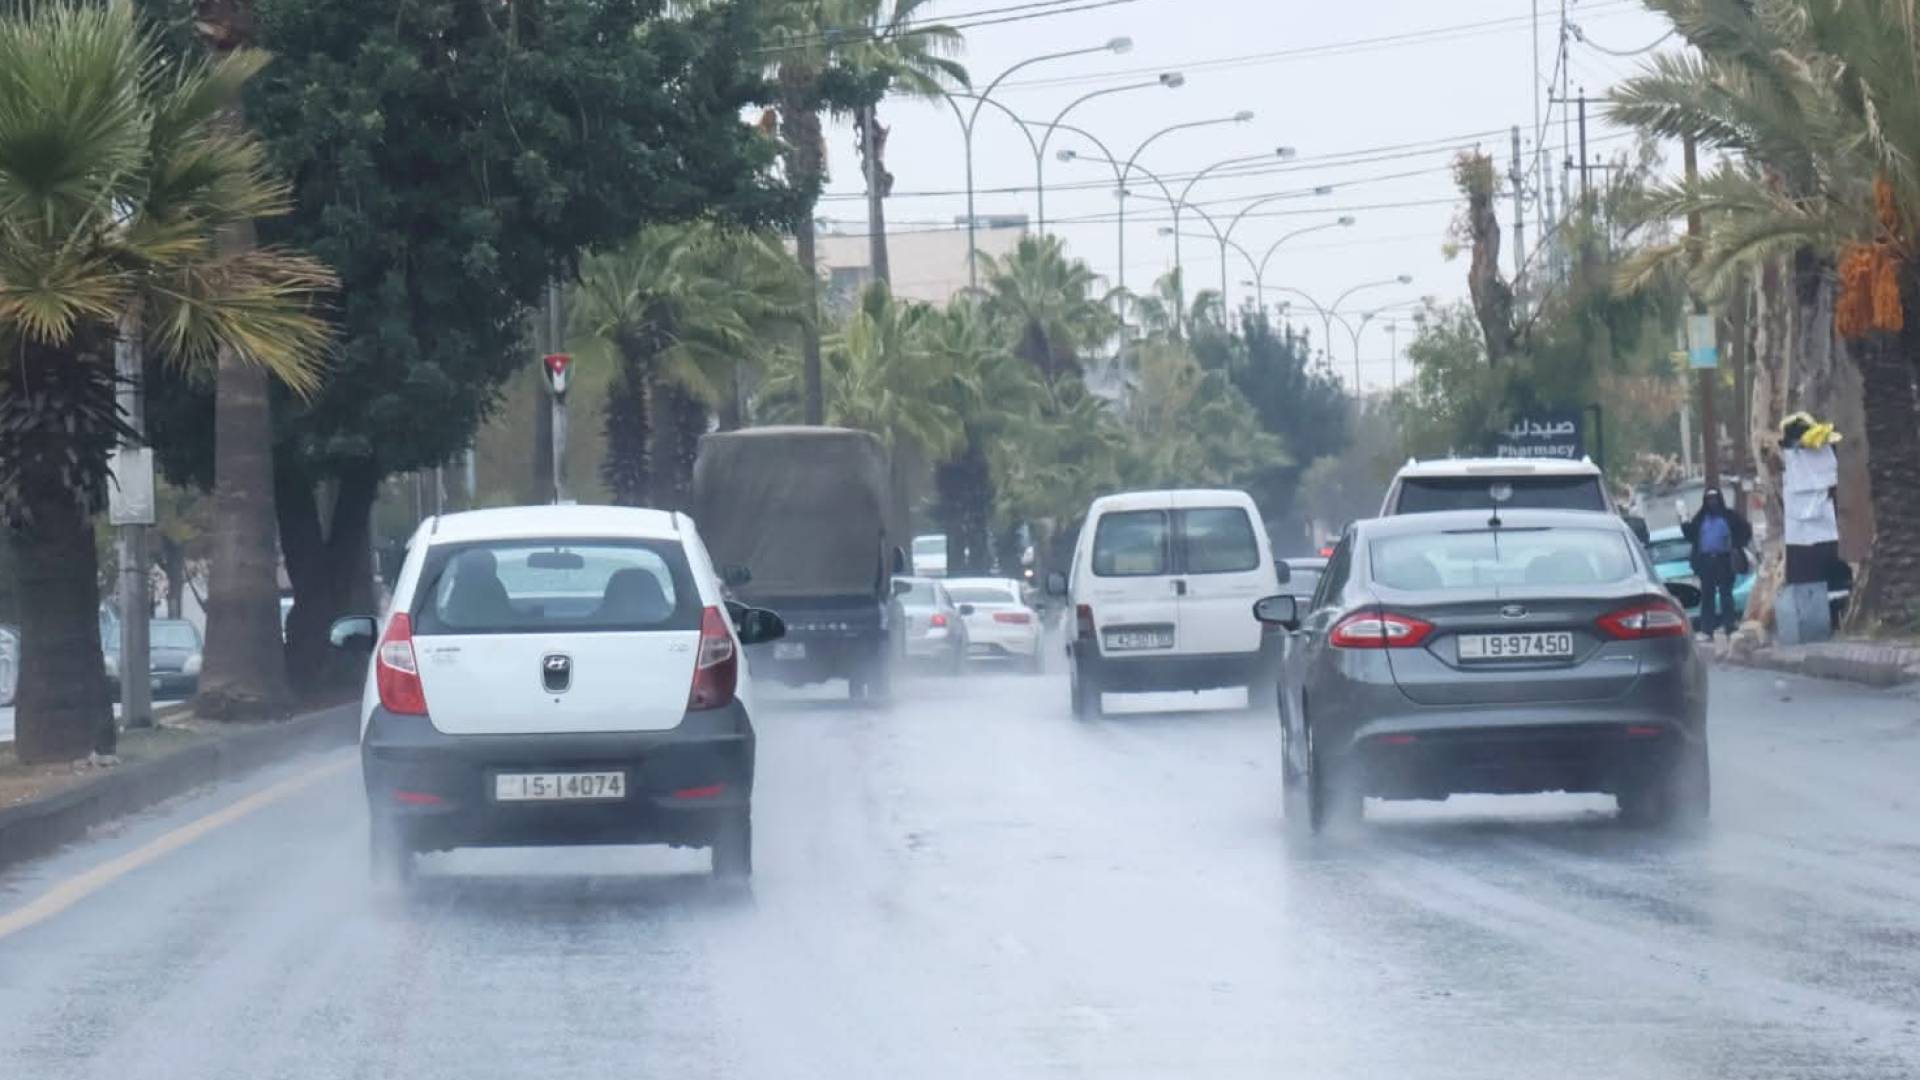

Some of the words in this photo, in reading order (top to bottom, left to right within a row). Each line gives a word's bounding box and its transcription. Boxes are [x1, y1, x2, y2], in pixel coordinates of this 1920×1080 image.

[1501, 419, 1575, 440] صيدلي
[1498, 445, 1575, 458] Pharmacy
[1482, 634, 1570, 656] 19-97450
[522, 775, 622, 798] 15-14074
